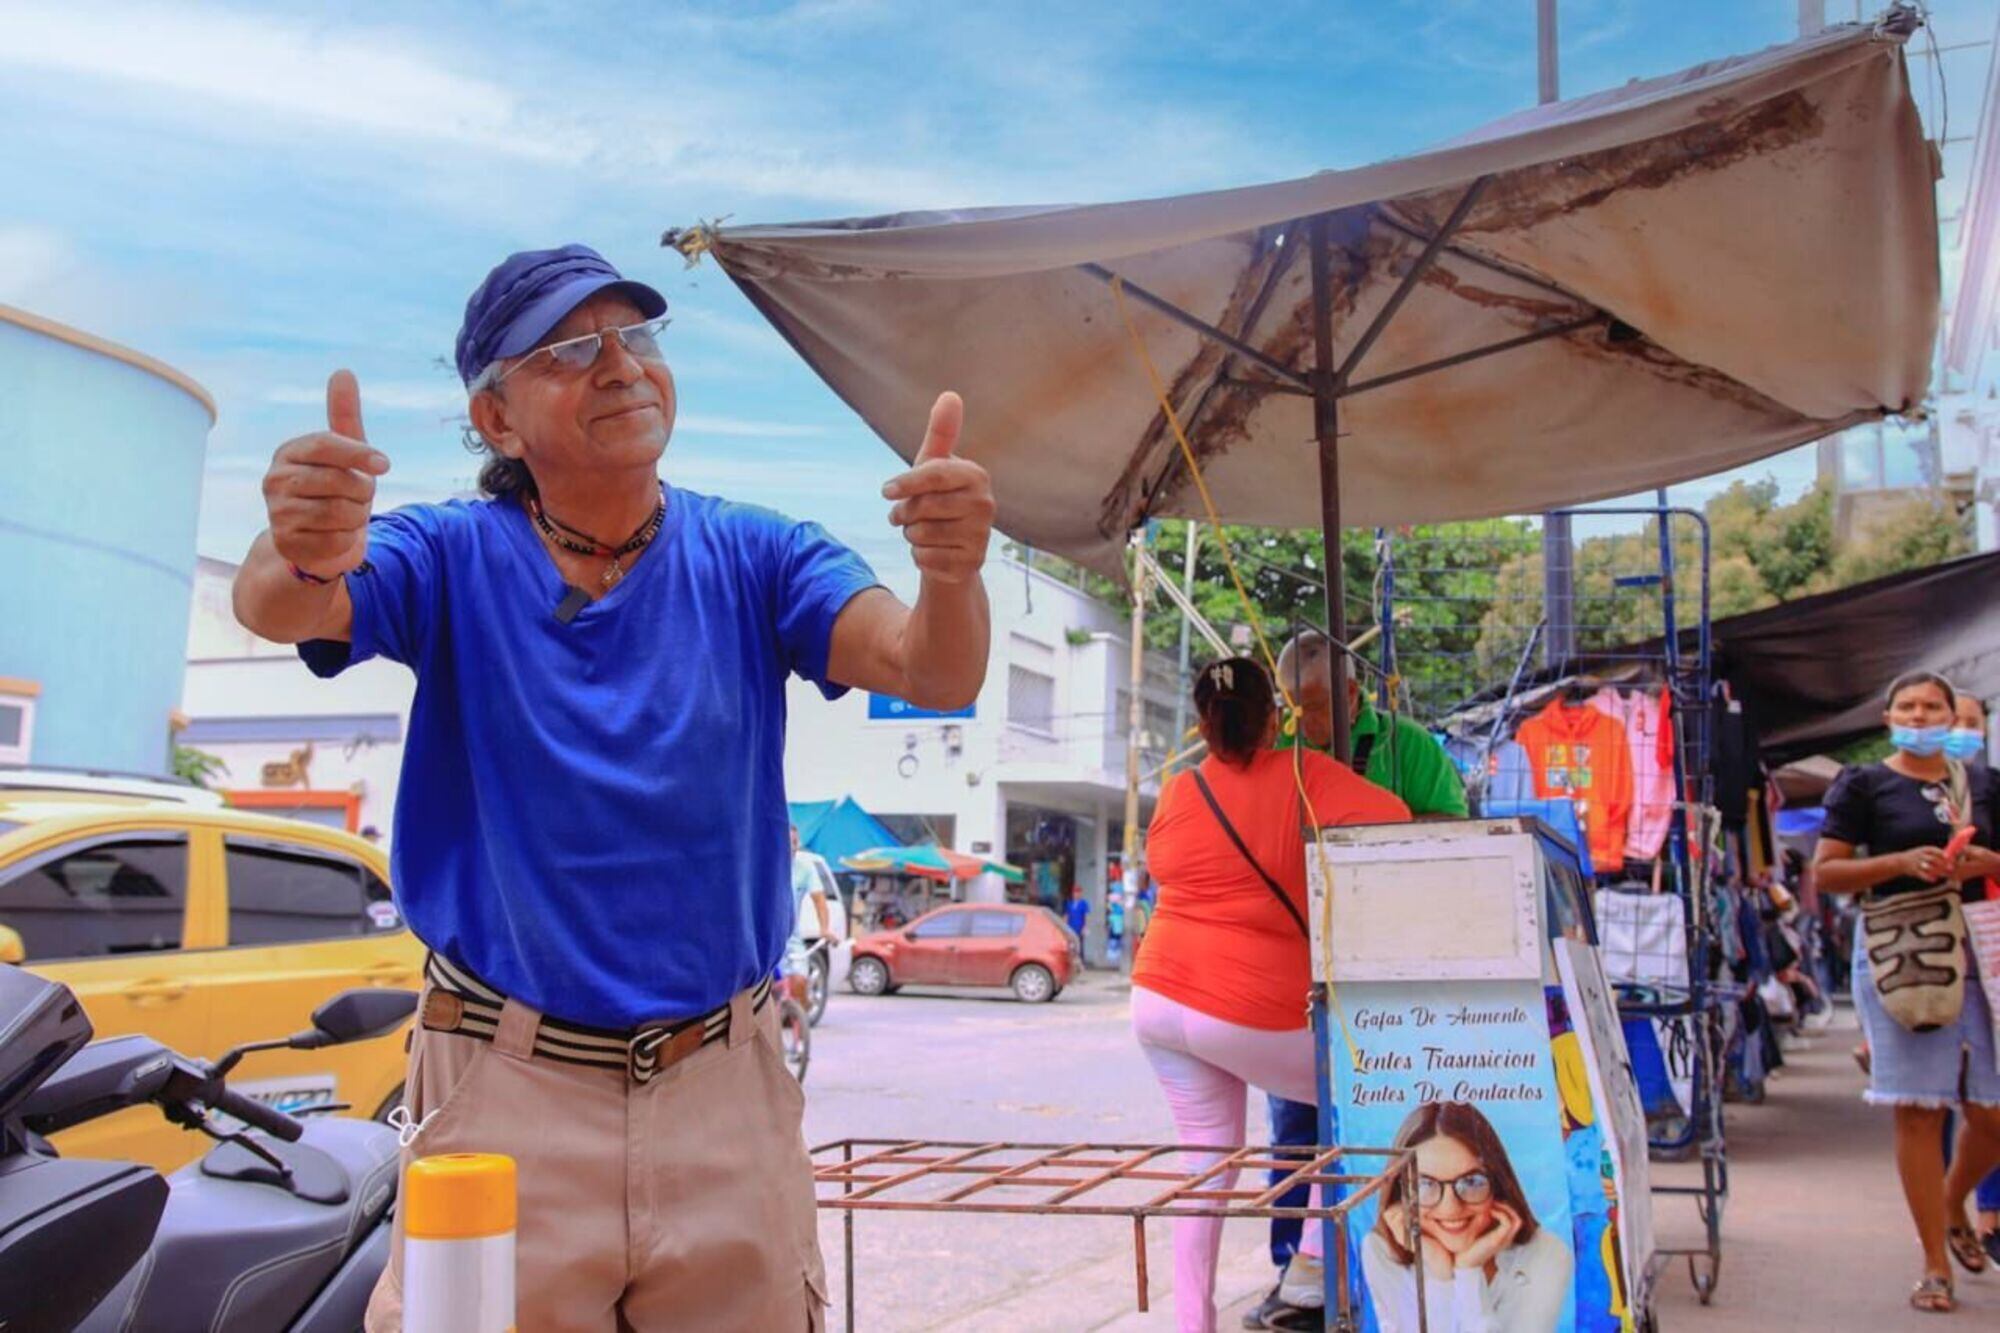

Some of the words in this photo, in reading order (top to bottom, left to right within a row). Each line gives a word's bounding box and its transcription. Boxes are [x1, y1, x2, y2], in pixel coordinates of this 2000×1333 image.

[1354, 1008, 1403, 1032] Gafas
[1410, 1006, 1436, 1027] De
[1446, 1006, 1527, 1026] Aumento
[1353, 1048, 1412, 1075] Lentes
[1352, 1082, 1405, 1106] Lentes
[1414, 1081, 1443, 1103] De
[1453, 1080, 1543, 1101] Contactos
